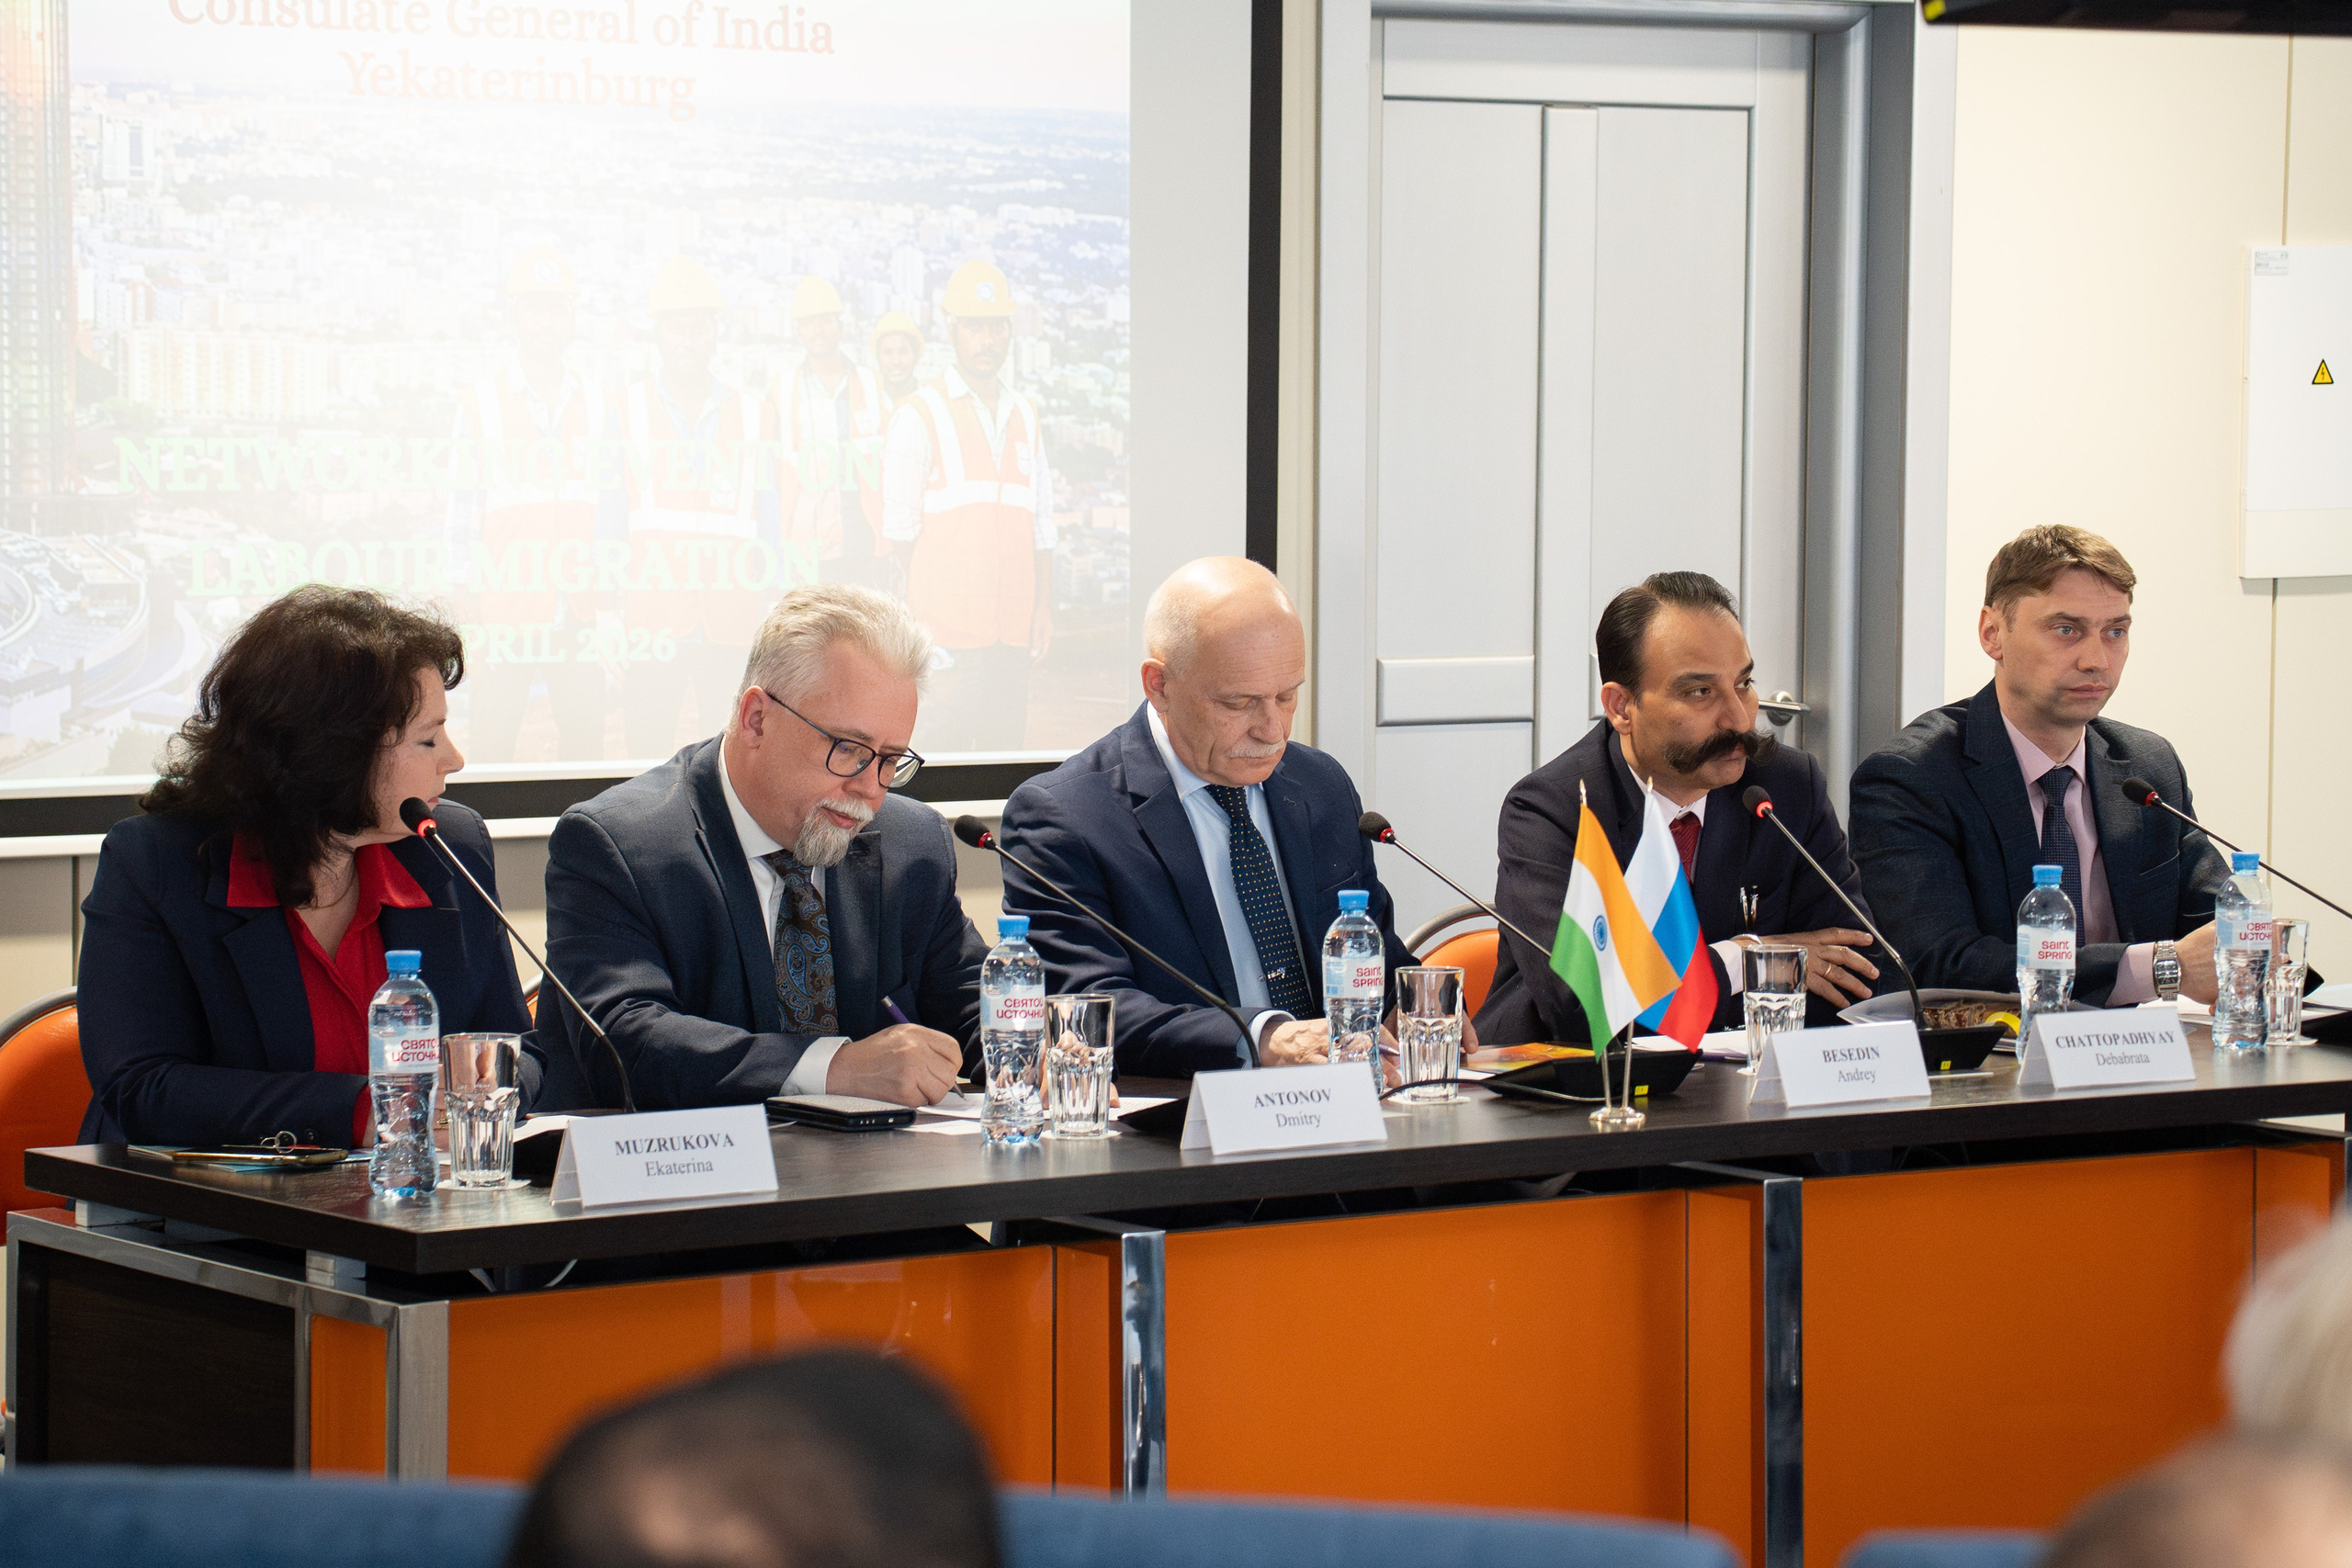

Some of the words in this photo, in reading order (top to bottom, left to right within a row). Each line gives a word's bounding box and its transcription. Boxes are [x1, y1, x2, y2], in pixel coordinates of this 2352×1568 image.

[445, 0, 638, 47] General
[650, 3, 703, 49] of
[712, 6, 835, 55] India
[336, 50, 697, 121] Yekaterinburg
[114, 435, 567, 493] NETWORKING
[582, 436, 783, 492] EVENT
[797, 439, 886, 493] ON
[187, 537, 453, 598] LABOUR
[467, 537, 824, 594] MIGRATION
[456, 623, 567, 664] PRIL
[576, 626, 678, 663] 2026
[2055, 1031, 2175, 1048] CHATTOPADHYAY
[1822, 1045, 1881, 1063] BESEDIN
[2096, 1052, 2151, 1066] Debabrata
[1838, 1066, 1876, 1083] Andrey
[1254, 1088, 1331, 1108] ANTONOV
[1275, 1111, 1321, 1128] Dmitry
[615, 1133, 735, 1156] MUZRUKOVA
[645, 1157, 714, 1177] Ekaterina
